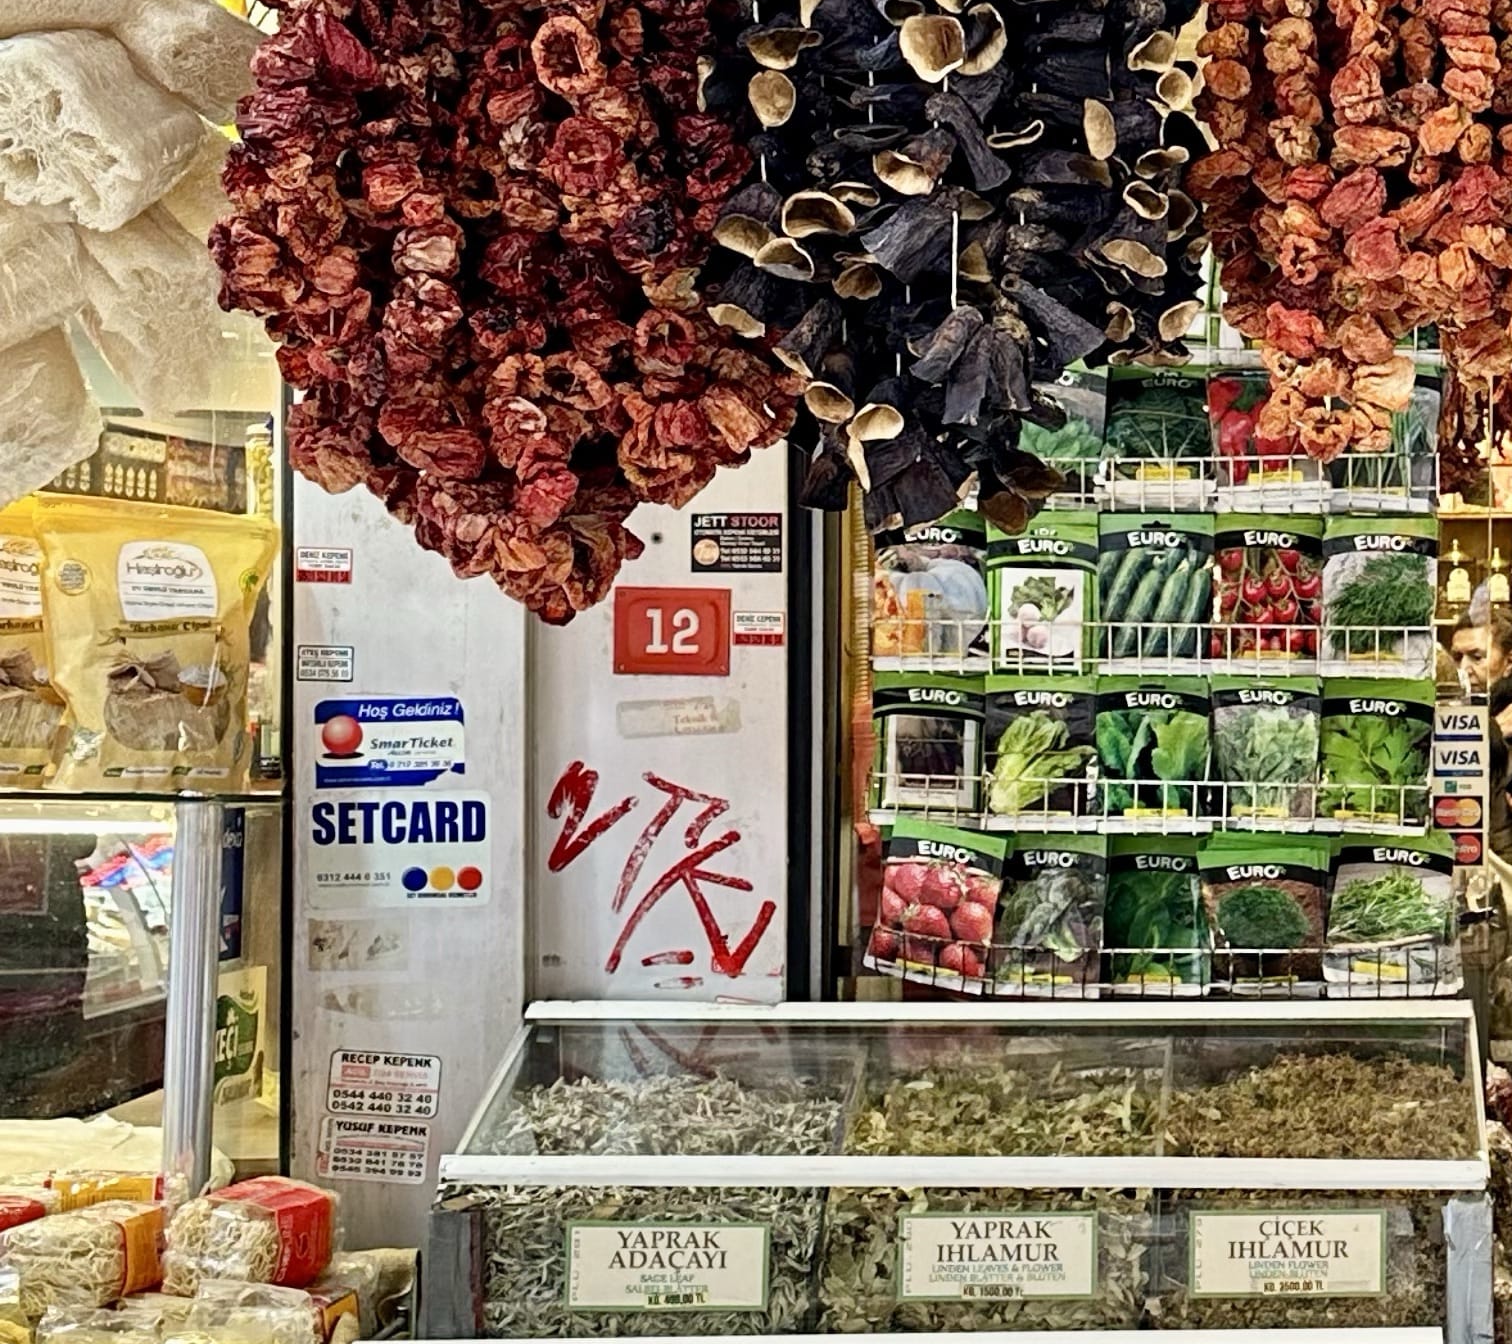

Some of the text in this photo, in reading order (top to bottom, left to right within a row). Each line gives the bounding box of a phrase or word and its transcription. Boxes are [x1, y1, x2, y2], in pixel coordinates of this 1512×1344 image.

[694, 516, 779, 528] JETT STOOR
[1017, 538, 1069, 556] EURO
[1128, 531, 1180, 548] EURO
[1244, 530, 1293, 549] EURO
[1353, 534, 1406, 552] EURO
[646, 608, 700, 654] 12
[908, 688, 961, 705] EURO
[1014, 691, 1067, 707] EURO
[1125, 692, 1176, 709] EURO
[1238, 689, 1287, 704] EURO
[358, 703, 388, 720] Hoş
[1349, 699, 1400, 716] EURO
[1440, 714, 1481, 731] VISA
[1440, 749, 1481, 766] VISA
[312, 800, 486, 845] SETCARD
[917, 841, 971, 864] EURO
[1023, 849, 1074, 867] EURO
[1373, 847, 1424, 865] EURO
[1136, 855, 1185, 872] EURO
[344, 872, 361, 881] 444
[1226, 864, 1280, 882] EURO
[342, 1052, 432, 1068] RECEP KEPENK
[333, 1089, 432, 1104] 0544 440 32 40
[332, 1101, 431, 1115] 0542 440 32 40
[336, 1121, 427, 1137] YUSUF KEPENK
[951, 1221, 1053, 1240] YAPRAK
[1259, 1216, 1325, 1240] ÇİÇEK
[617, 1231, 720, 1249] YAPRAK
[936, 1243, 1058, 1263] IHLAMUR
[1228, 1240, 1349, 1259] IHLAMUR
[608, 1250, 728, 1274] ADAÇAYI
